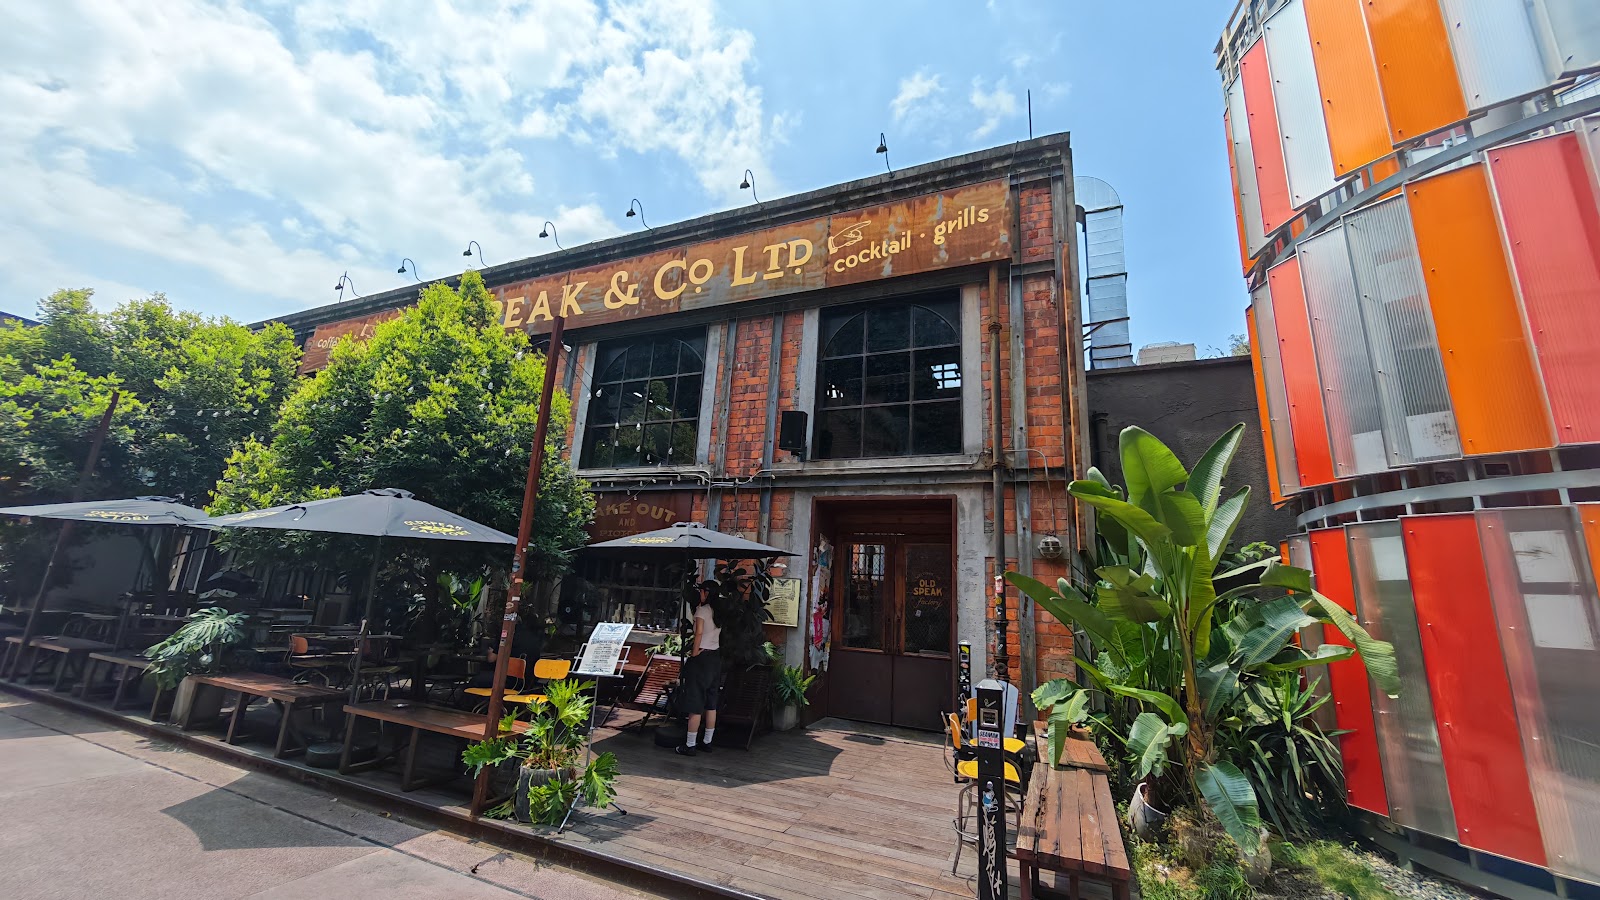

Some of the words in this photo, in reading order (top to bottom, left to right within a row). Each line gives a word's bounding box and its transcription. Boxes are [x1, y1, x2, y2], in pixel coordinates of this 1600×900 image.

[833, 231, 912, 273] cocktail
[933, 205, 990, 246] grills
[603, 270, 640, 310] &
[594, 503, 631, 518] AKE
[636, 503, 677, 523] OUT
[618, 518, 636, 527] AND
[919, 579, 936, 588] OLD
[912, 587, 943, 597] SPEAK
